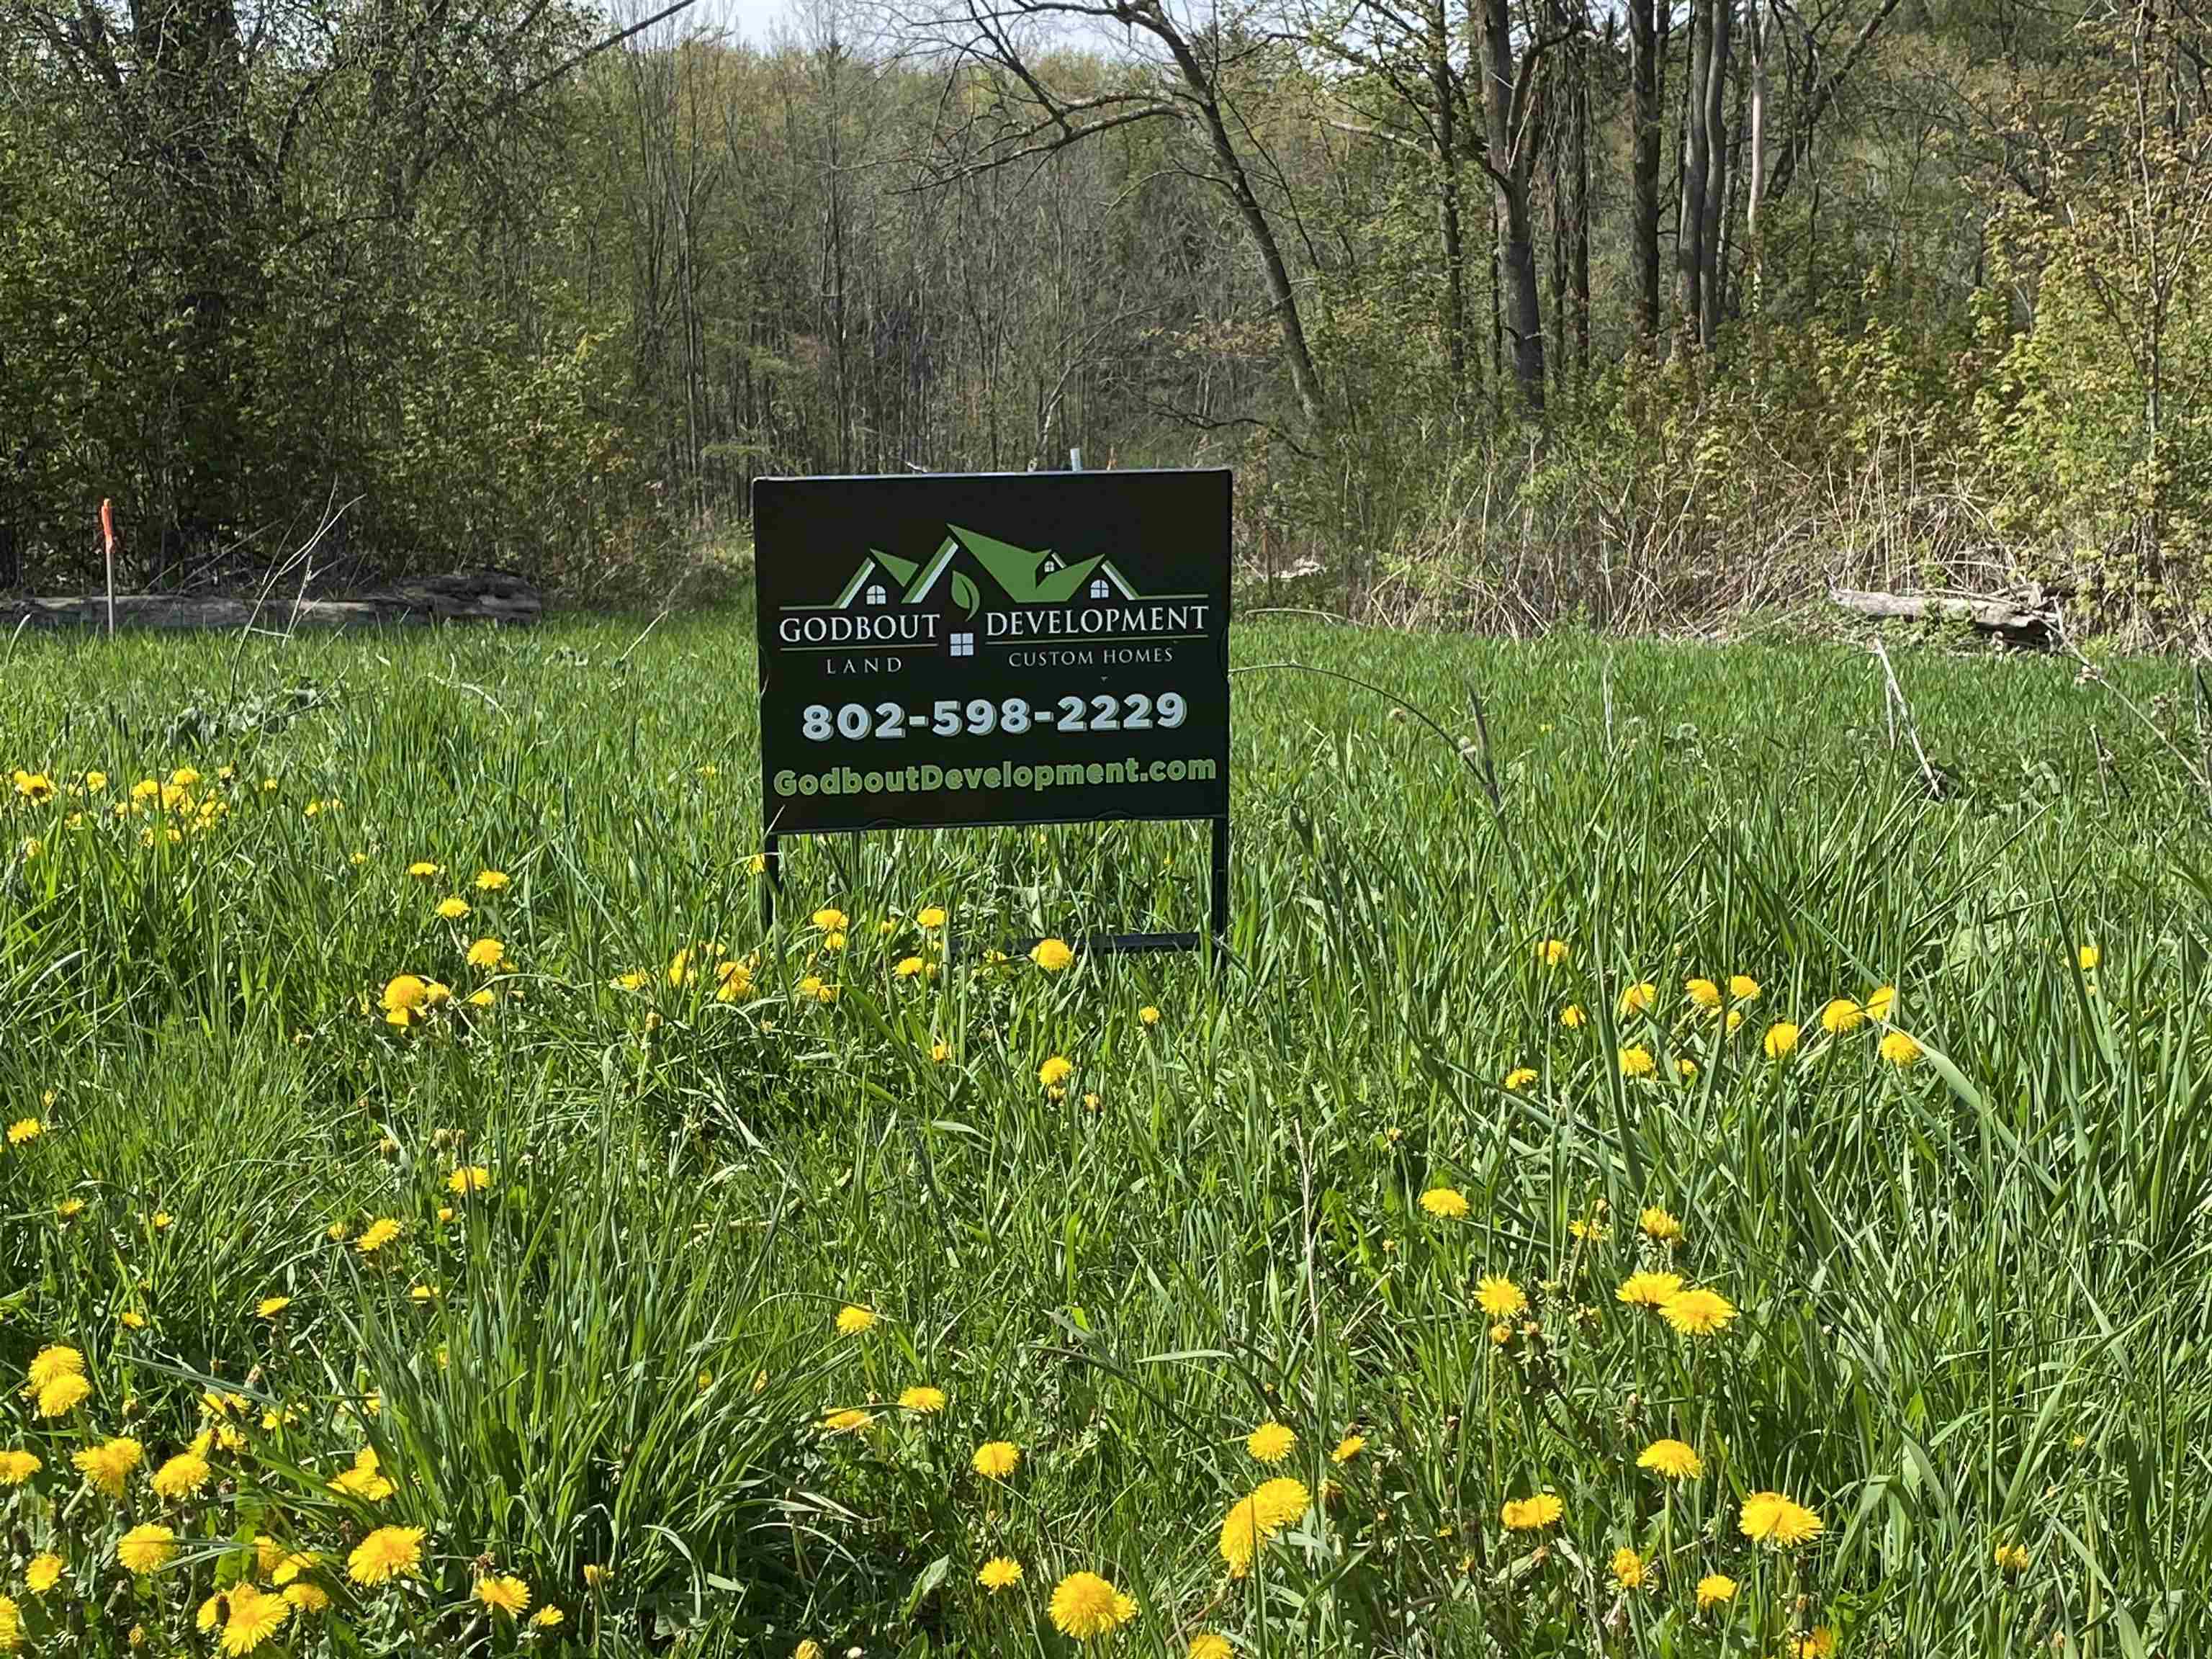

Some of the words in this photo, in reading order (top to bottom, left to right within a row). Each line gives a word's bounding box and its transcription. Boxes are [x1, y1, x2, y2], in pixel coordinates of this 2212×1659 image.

[779, 613, 940, 642] GODBOUT
[986, 605, 1210, 637] DEVELOPMENT
[827, 657, 903, 675] LAND
[1008, 649, 1093, 668] CUSTOM
[1103, 647, 1174, 665] HOMES
[801, 692, 1188, 742] 802-598-2229
[773, 756, 1216, 797] GodboutDevelopment.com
